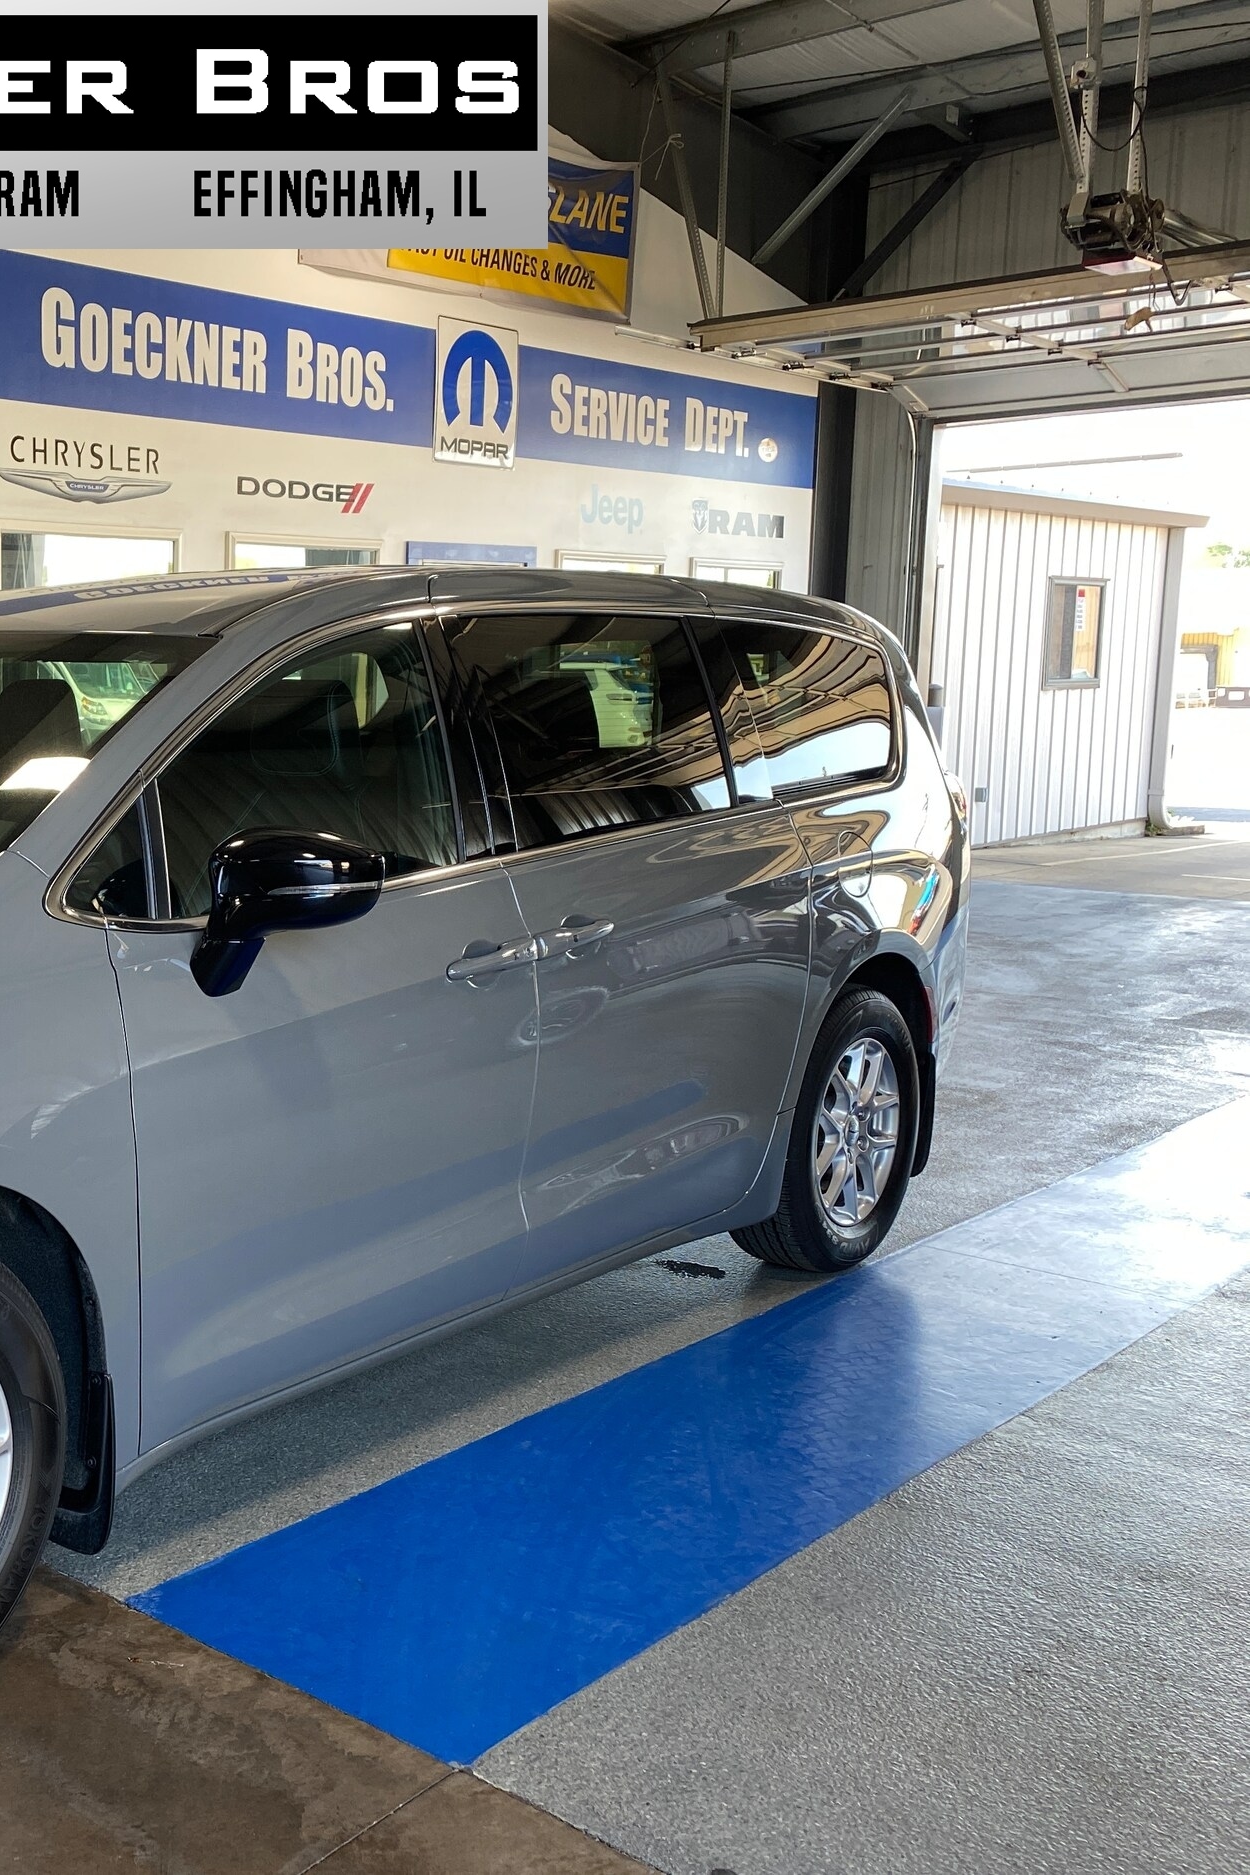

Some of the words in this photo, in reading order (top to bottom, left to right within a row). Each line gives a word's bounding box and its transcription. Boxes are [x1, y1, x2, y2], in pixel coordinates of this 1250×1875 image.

[471, 249, 537, 278] CHANGES
[540, 260, 550, 282] &
[554, 263, 596, 290] MORE
[9, 435, 160, 474] CHRYSLER
[440, 435, 509, 460] MOPAR
[69, 482, 106, 491] CHRYSLER
[236, 475, 357, 503] DODGE
[579, 483, 645, 535] Jeep
[707, 508, 785, 539] RAM
